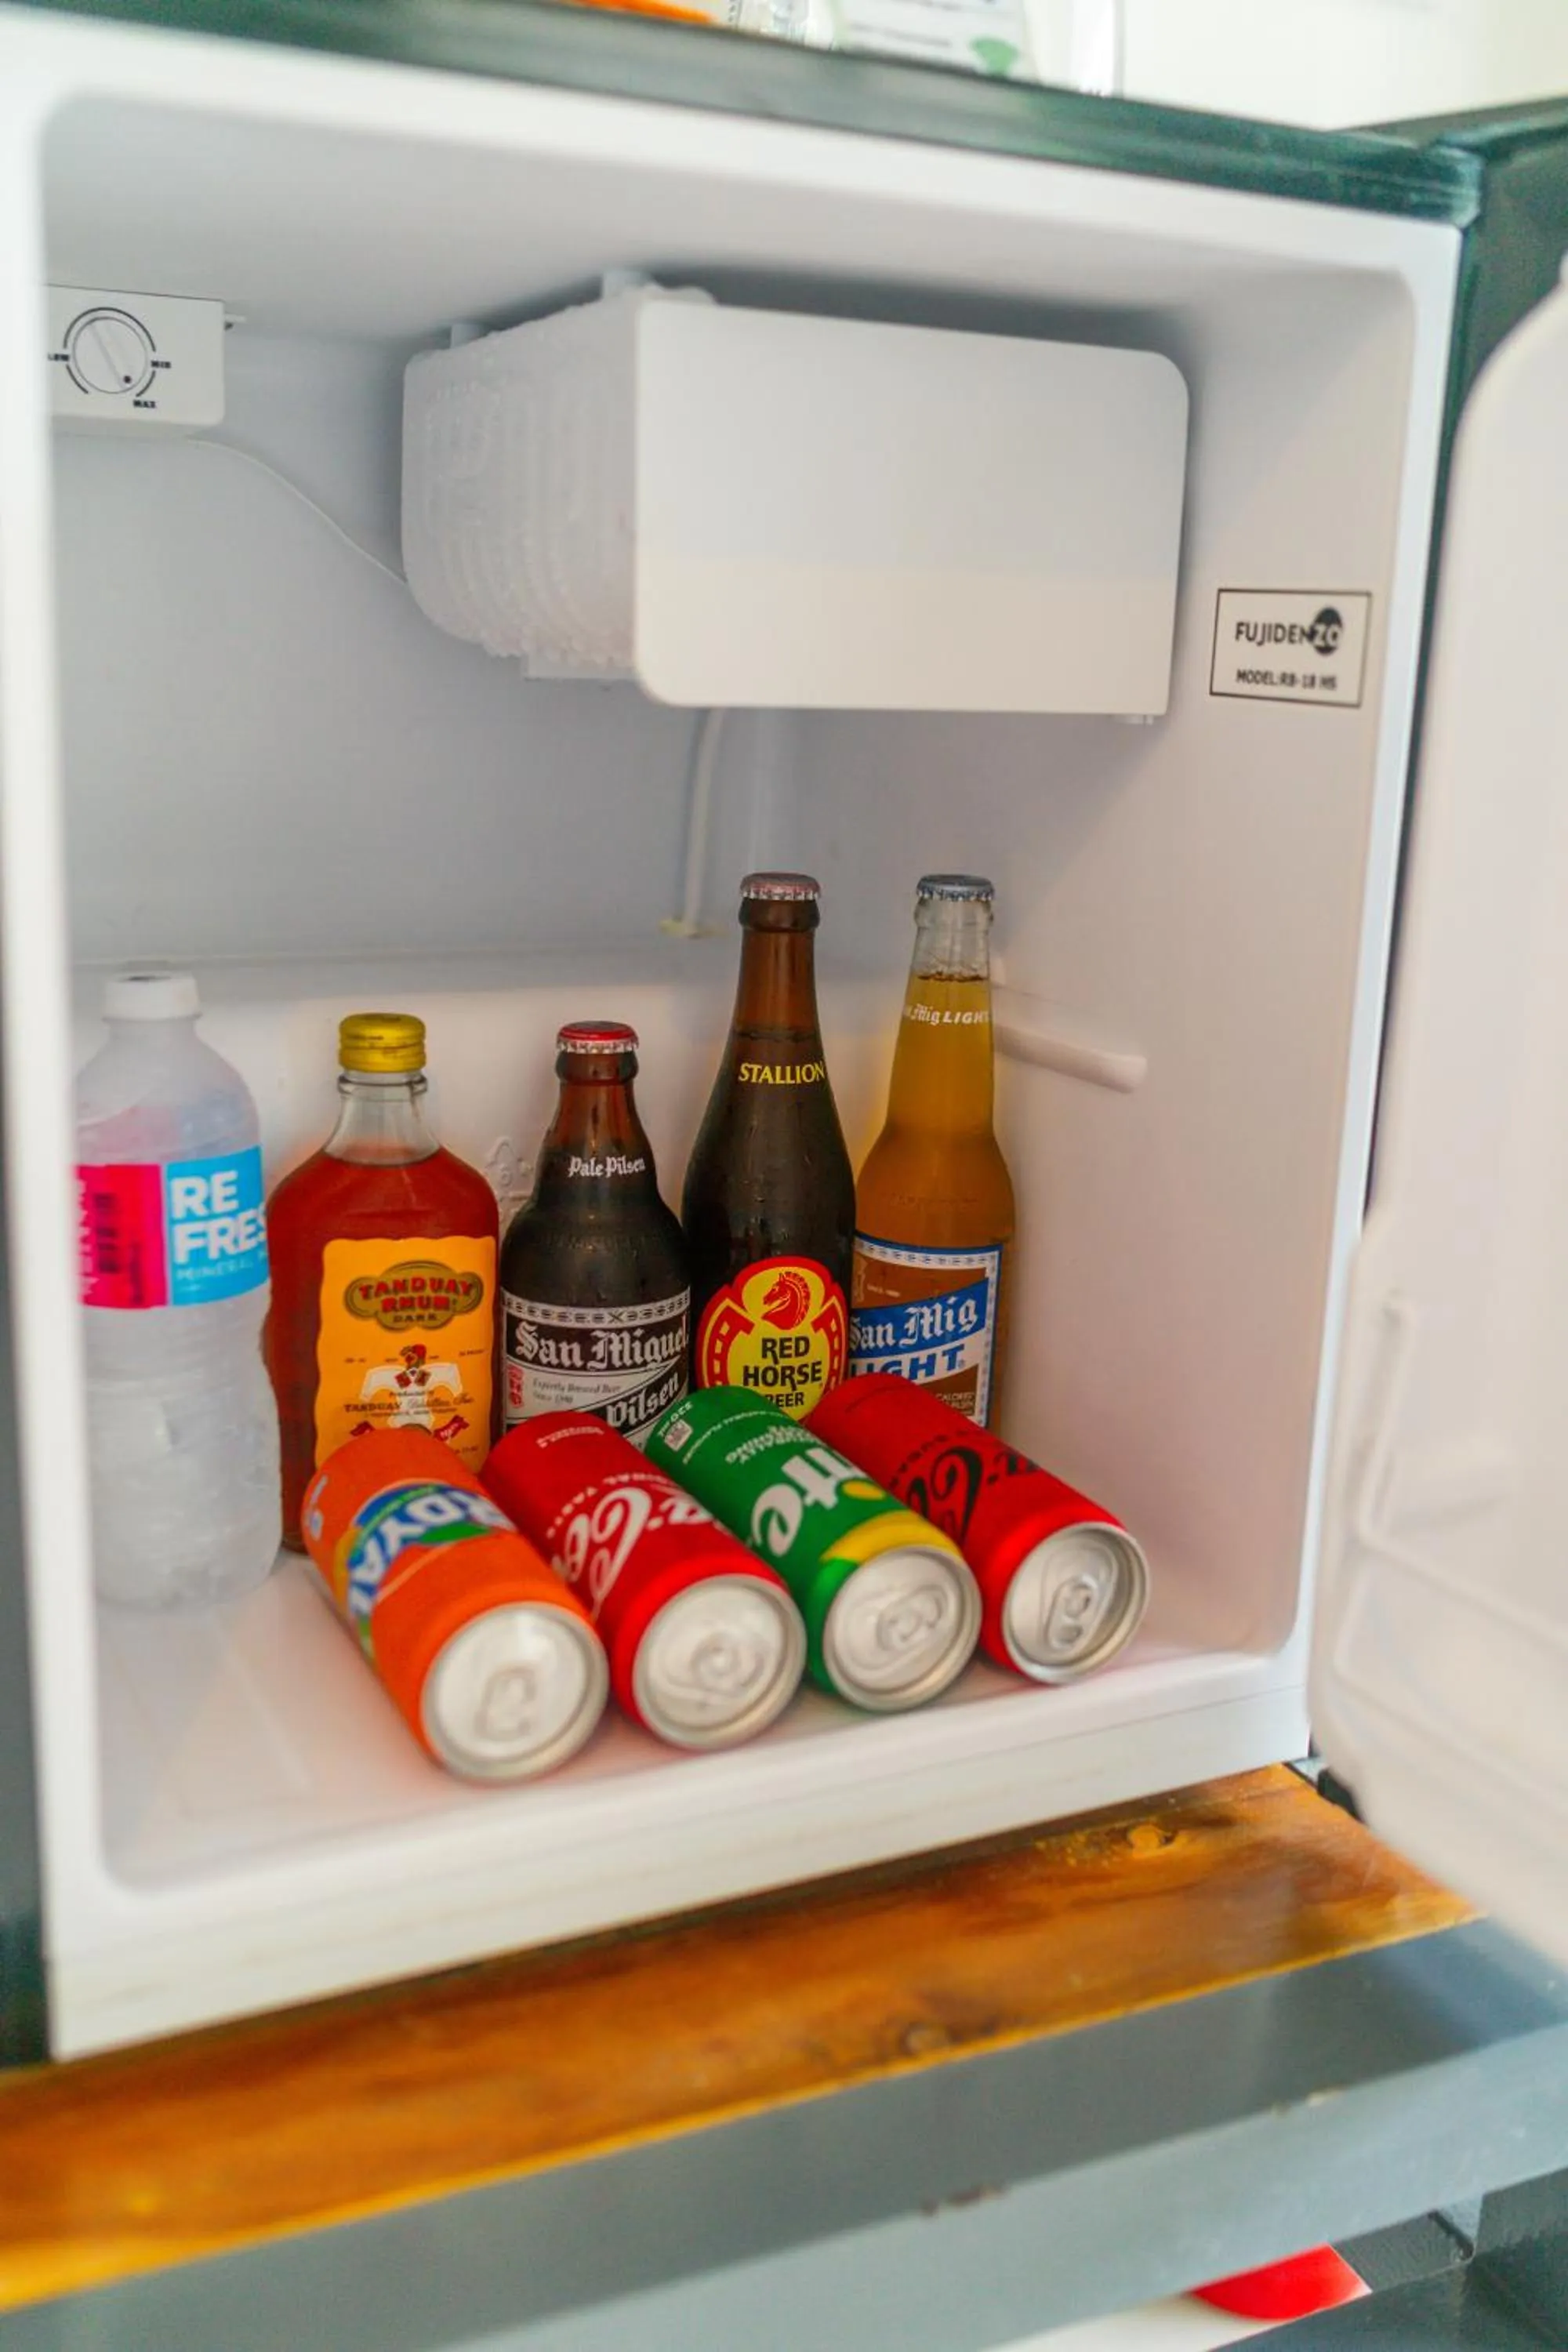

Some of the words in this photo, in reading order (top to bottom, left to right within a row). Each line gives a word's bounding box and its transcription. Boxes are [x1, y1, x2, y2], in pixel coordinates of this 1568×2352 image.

[1234, 621, 1340, 647] FUJIDENZO
[738, 1062, 826, 1084] STALLION
[567, 1155, 604, 1178] Pale
[169, 1170, 239, 1220] RE
[358, 1276, 474, 1301] TANDUAY
[381, 1295, 450, 1313] RHUM
[392, 1313, 437, 1323] DARK
[898, 1296, 979, 1348] Mig
[515, 1321, 583, 1368] San
[586, 1313, 688, 1370] Miguel
[760, 1336, 811, 1365] RED
[742, 1360, 822, 1391] HORSE
[606, 1373, 679, 1428] Pilsen
